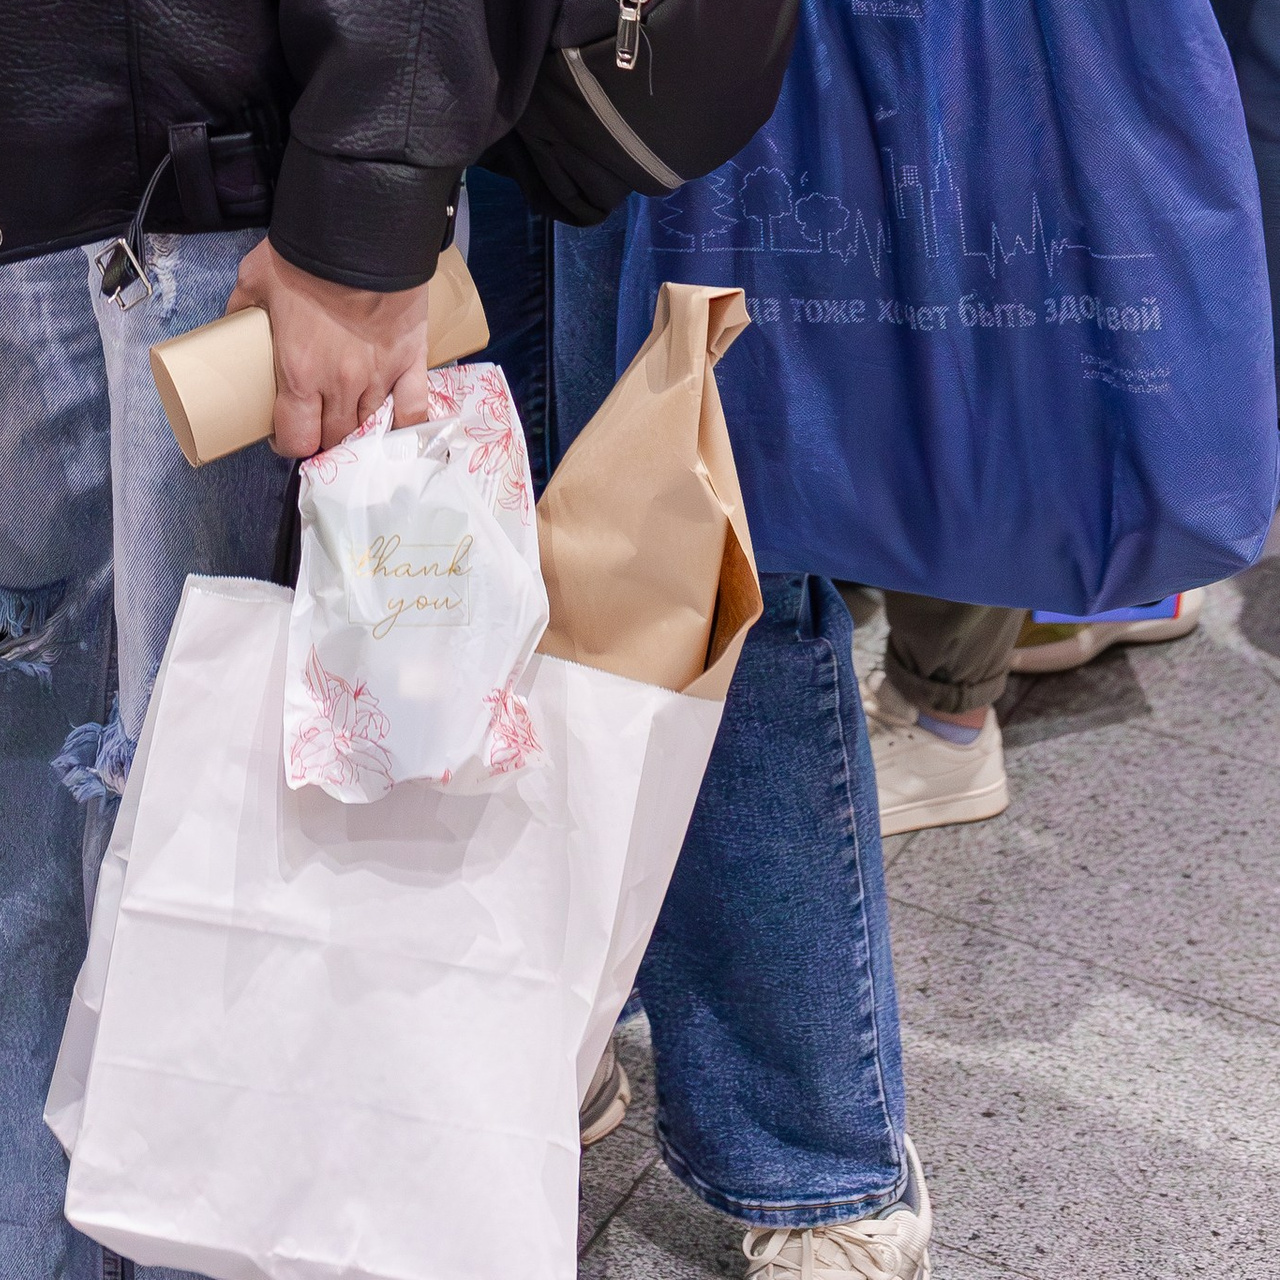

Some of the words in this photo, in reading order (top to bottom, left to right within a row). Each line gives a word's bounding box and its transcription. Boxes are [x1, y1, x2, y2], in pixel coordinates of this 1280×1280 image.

[791, 297, 866, 324] тоже
[877, 297, 949, 331] хочет
[959, 293, 1037, 327] быть
[351, 533, 474, 579] thank
[372, 596, 462, 640] you
